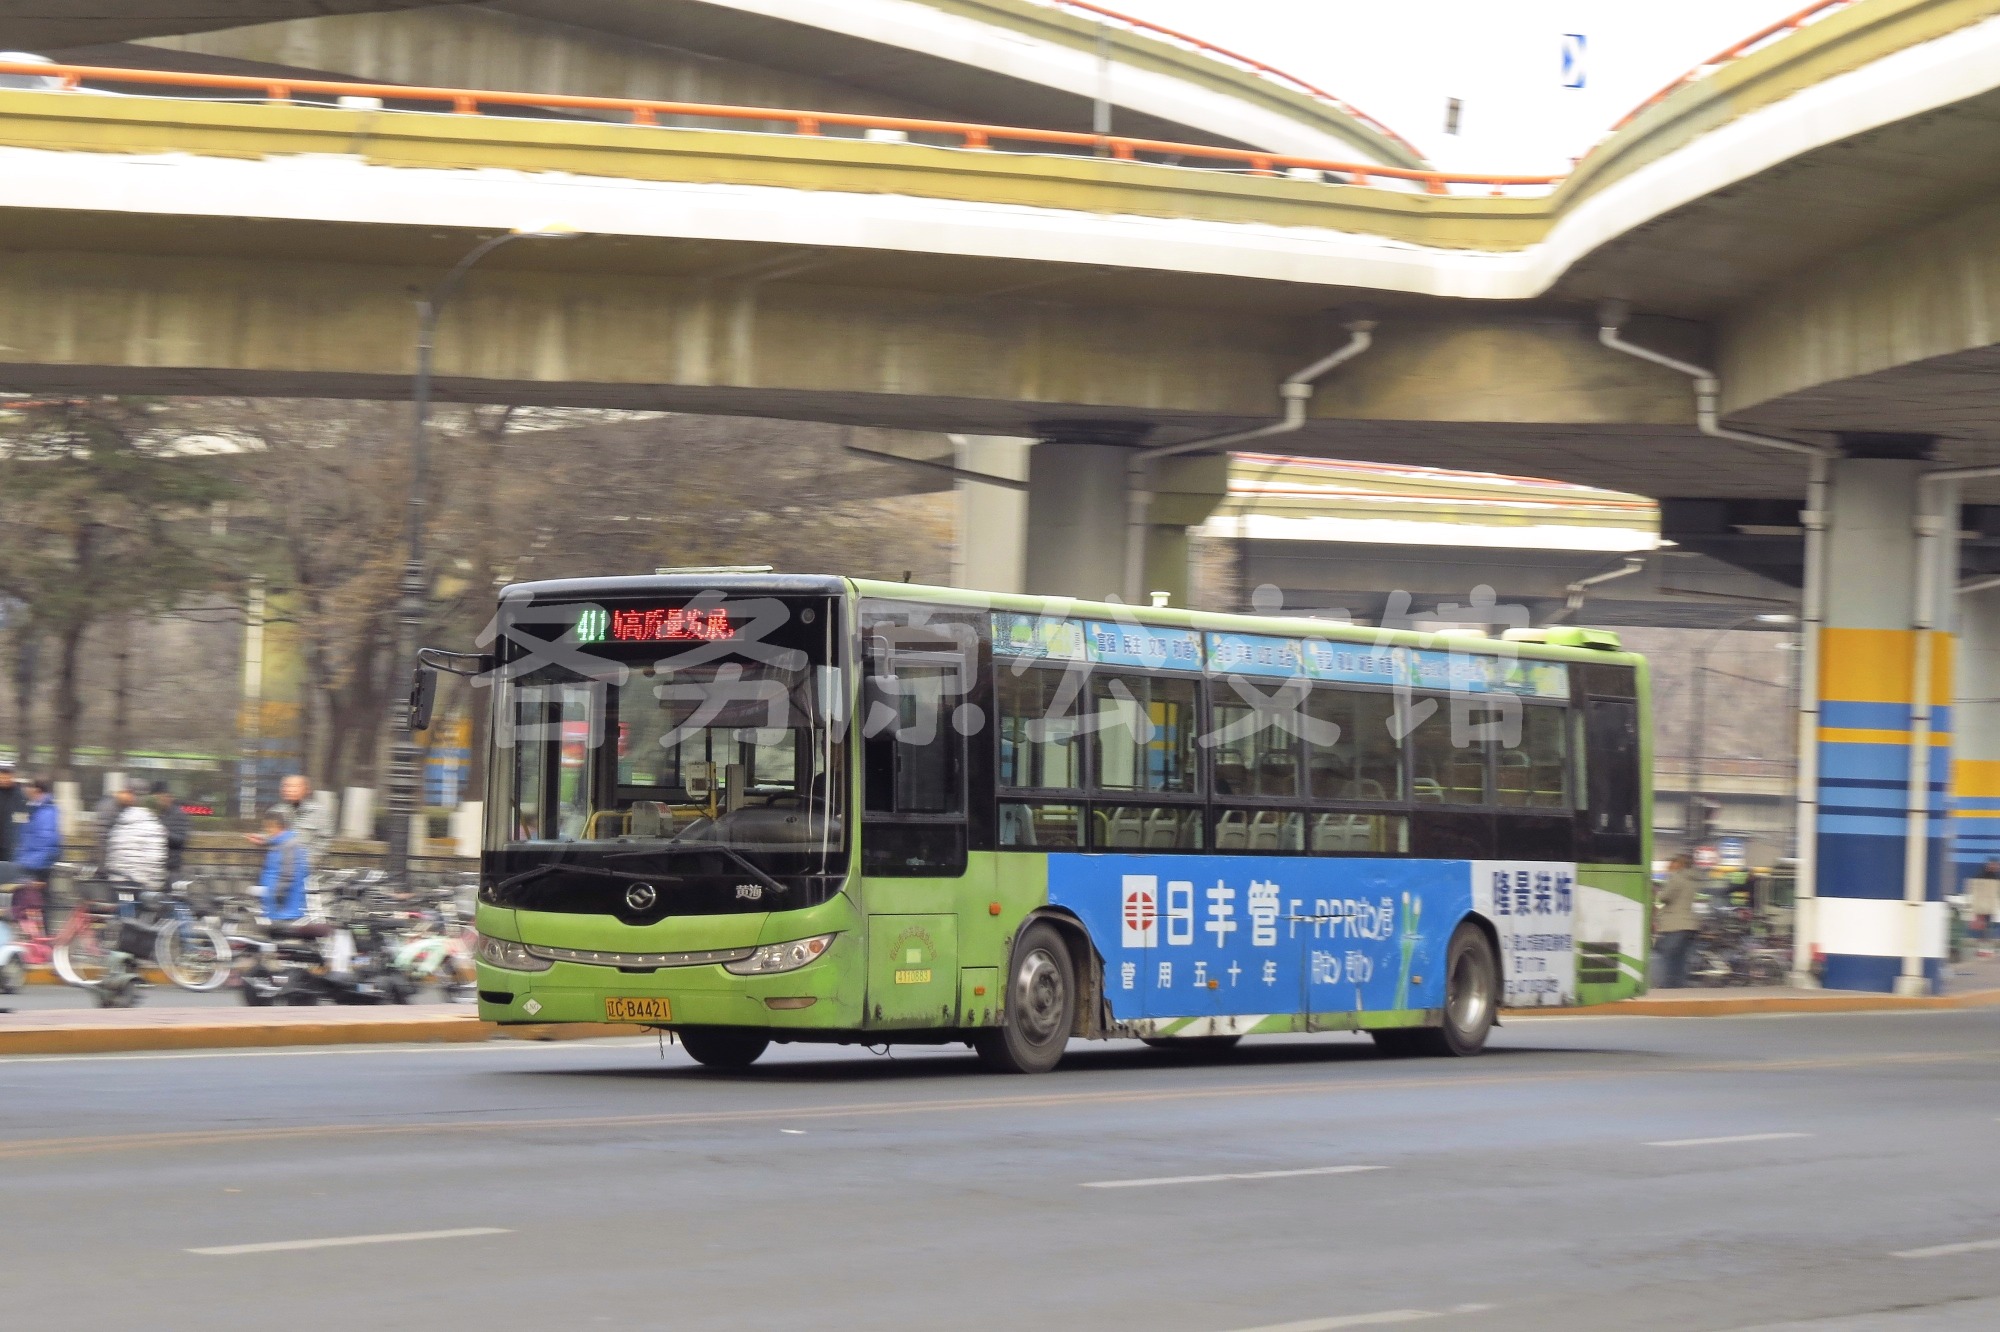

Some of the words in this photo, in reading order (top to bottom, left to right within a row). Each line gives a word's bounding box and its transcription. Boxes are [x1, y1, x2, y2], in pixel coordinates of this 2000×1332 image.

[577, 610, 607, 640] 411
[735, 884, 763, 899] 黄海
[1167, 879, 1280, 948] 日丰管
[1121, 959, 1278, 990] 管用五十年
